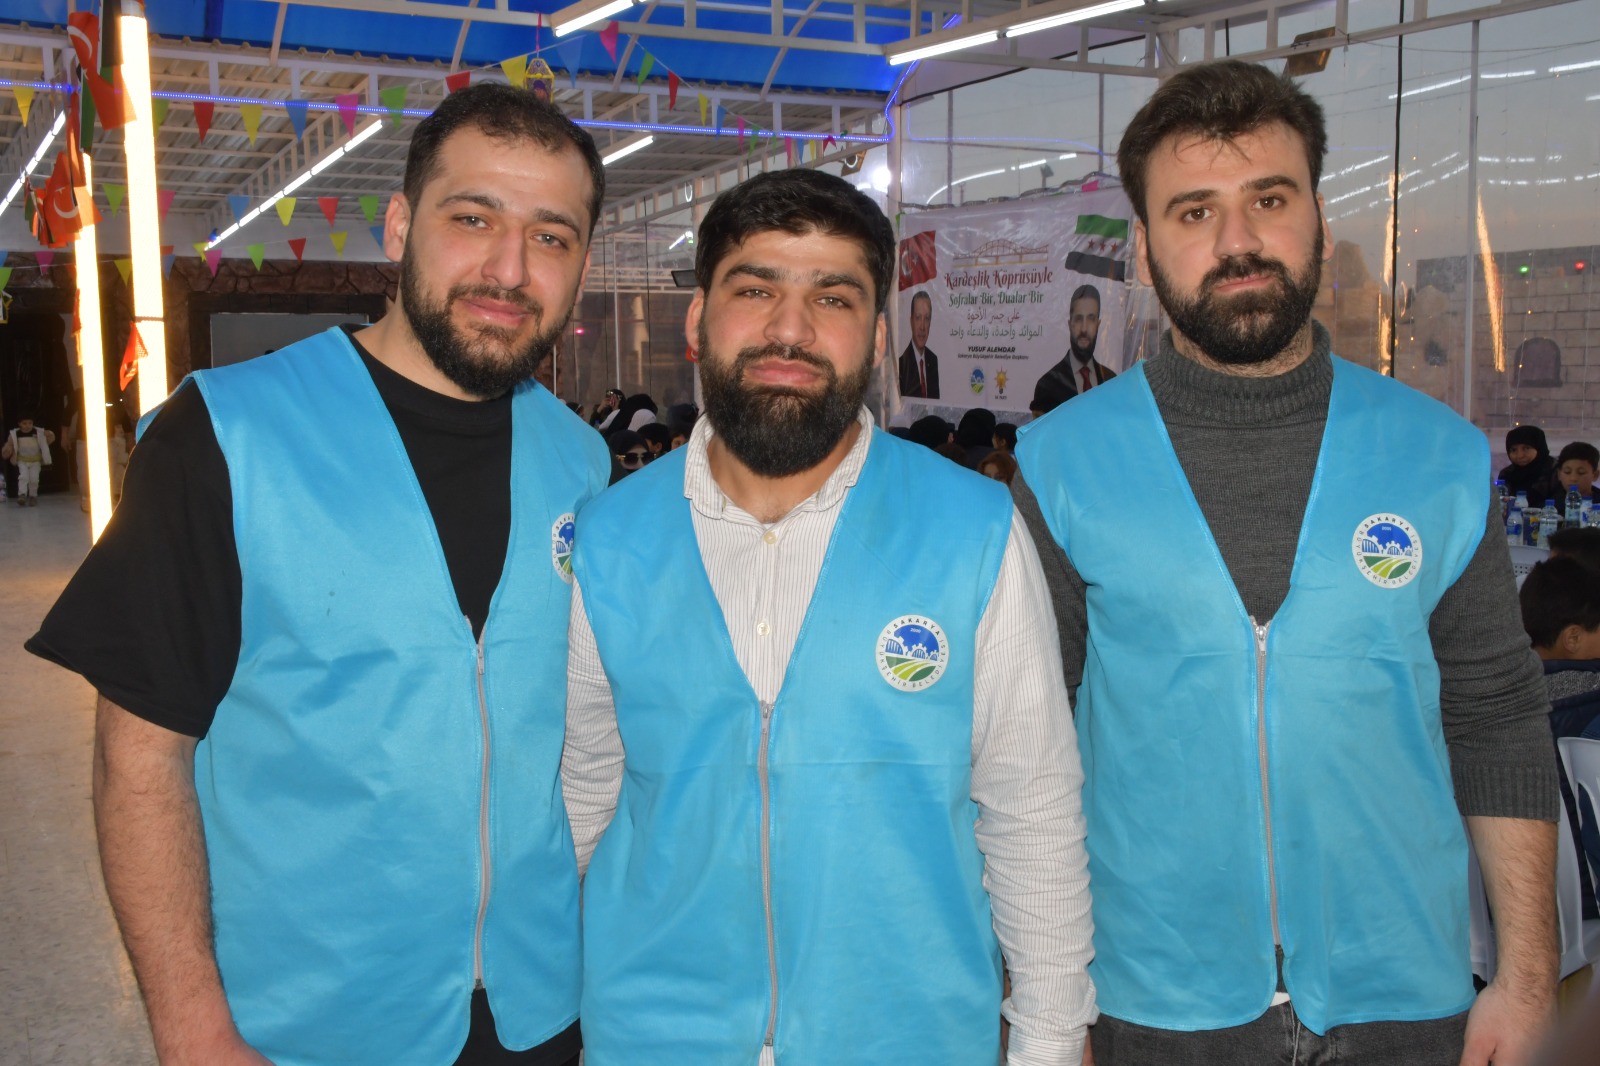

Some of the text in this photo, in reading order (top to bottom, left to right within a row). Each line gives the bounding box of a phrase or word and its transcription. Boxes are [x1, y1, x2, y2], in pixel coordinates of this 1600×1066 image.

[944, 267, 1053, 290] Kardeşlik Köprüsüyle
[949, 290, 1044, 308] Sofralar Bir, Dualar Bir
[967, 306, 1020, 324] على جسر الأخوة
[949, 326, 964, 340] واحد
[1018, 325, 1043, 341] الموائد
[1364, 516, 1410, 531] SAKARYA
[893, 618, 940, 636] SAKARYA
